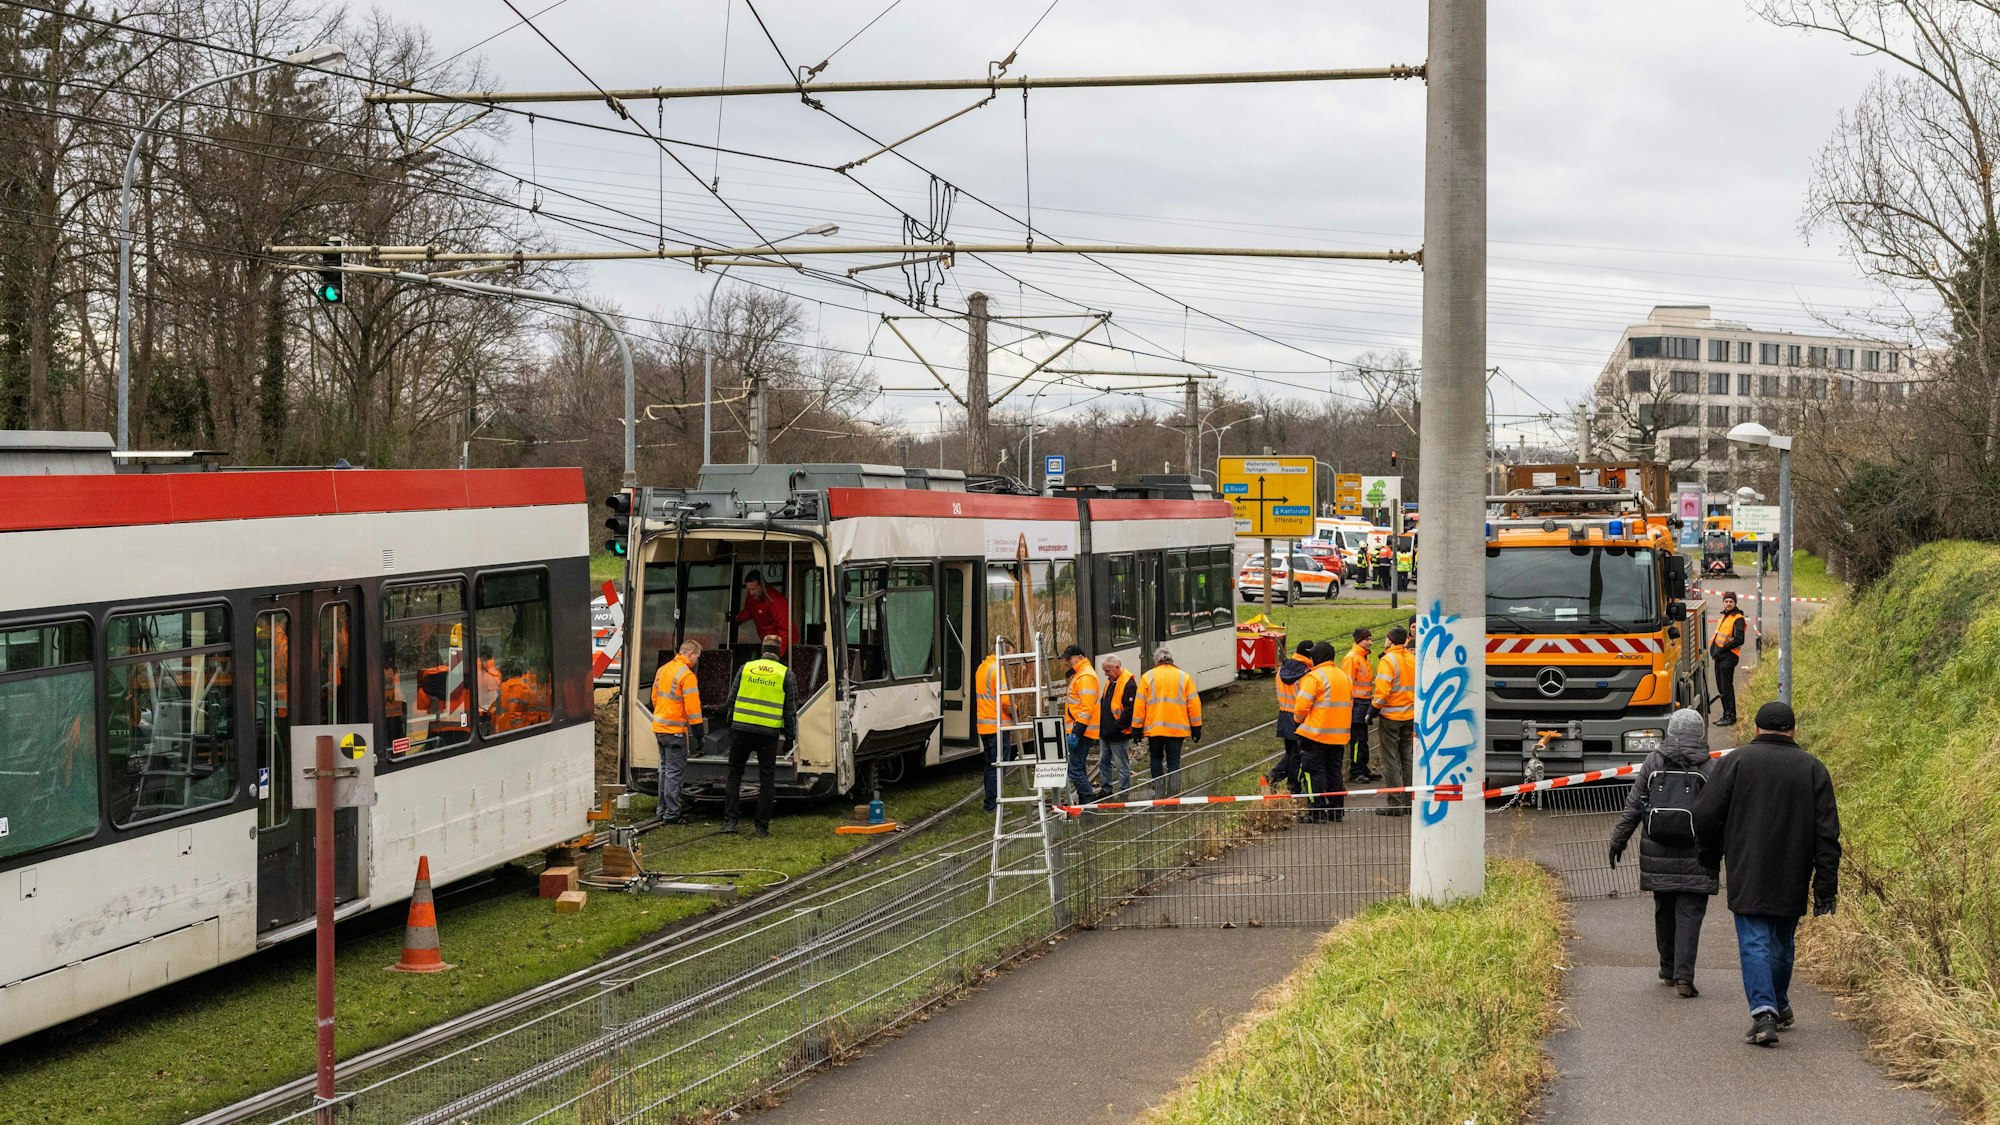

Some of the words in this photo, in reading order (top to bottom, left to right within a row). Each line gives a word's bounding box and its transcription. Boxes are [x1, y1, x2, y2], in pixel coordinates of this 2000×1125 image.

[952, 502, 962, 515] 243
[758, 665, 774, 673] VAG
[747, 676, 776, 687] Aufsicht
[1037, 721, 1064, 760] H
